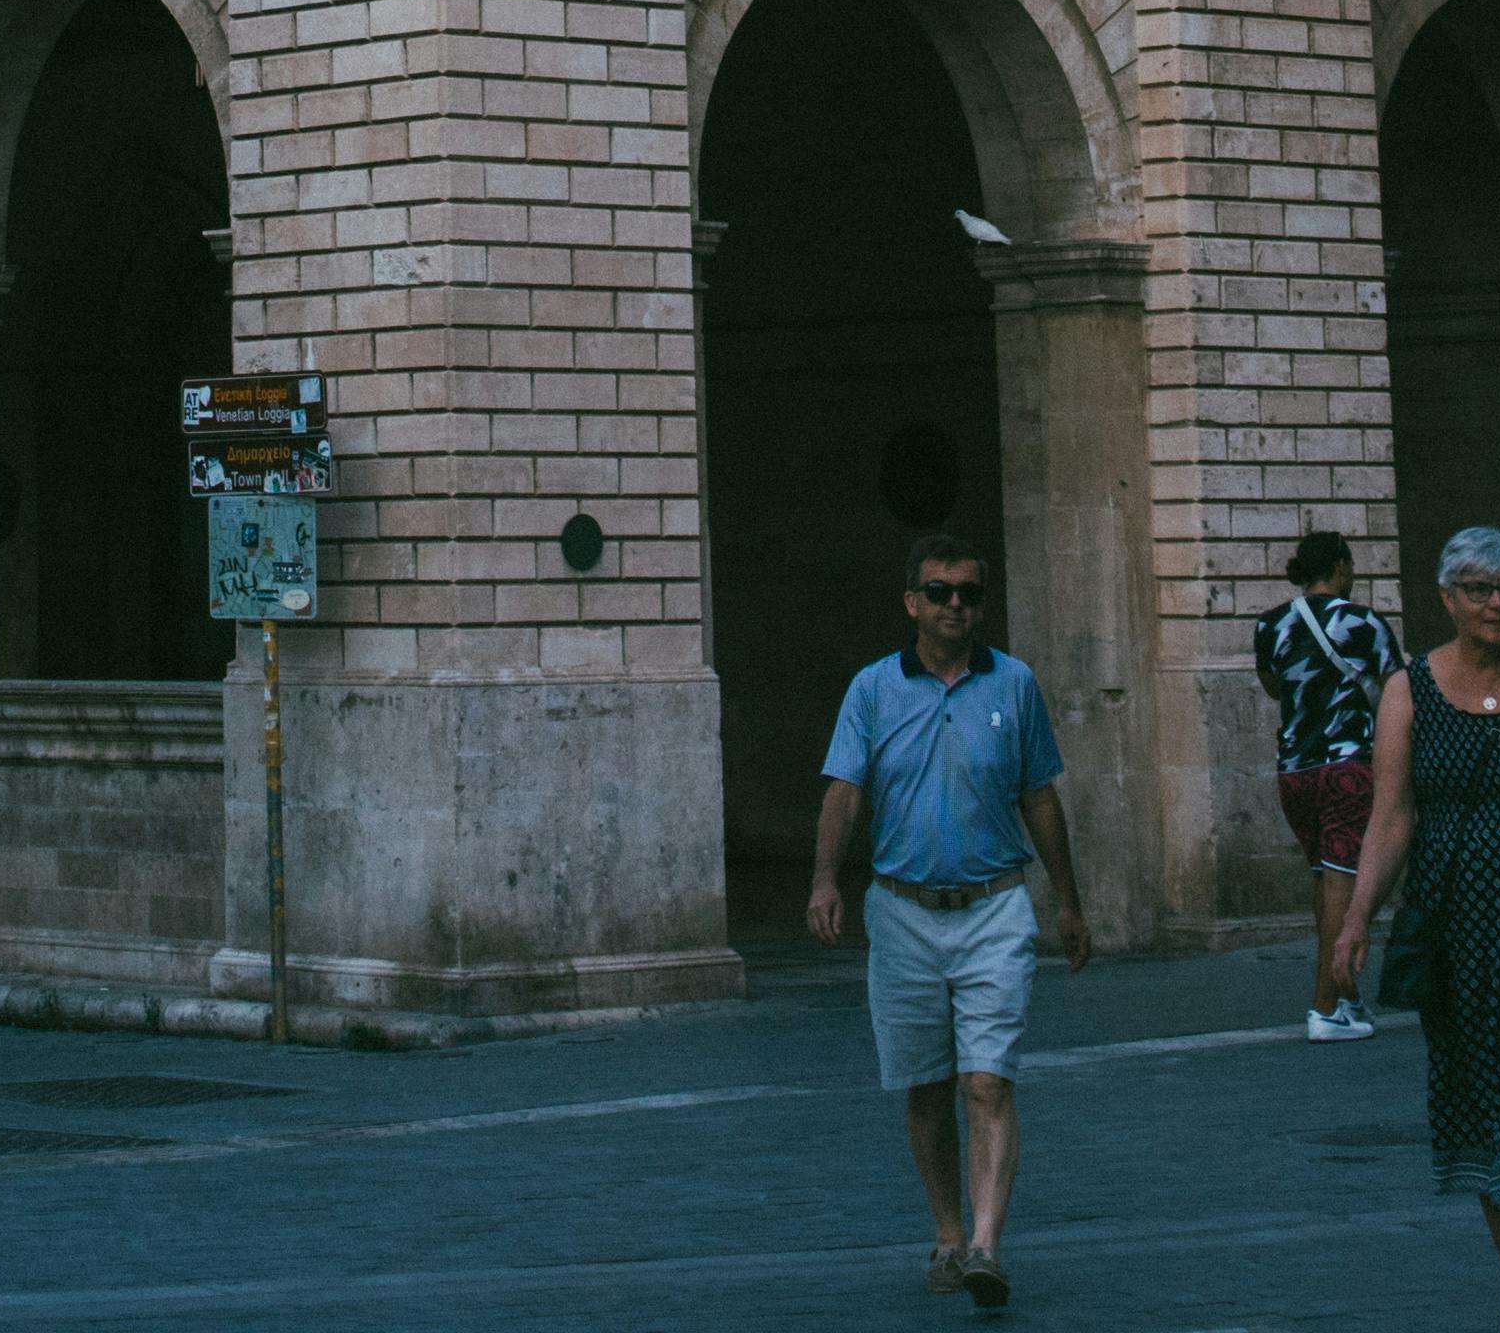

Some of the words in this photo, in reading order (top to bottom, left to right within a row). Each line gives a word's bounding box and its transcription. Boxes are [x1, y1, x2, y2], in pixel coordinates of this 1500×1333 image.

[214, 407, 255, 423] Venetian
[257, 406, 290, 424] Loggia
[231, 471, 262, 488] Town
